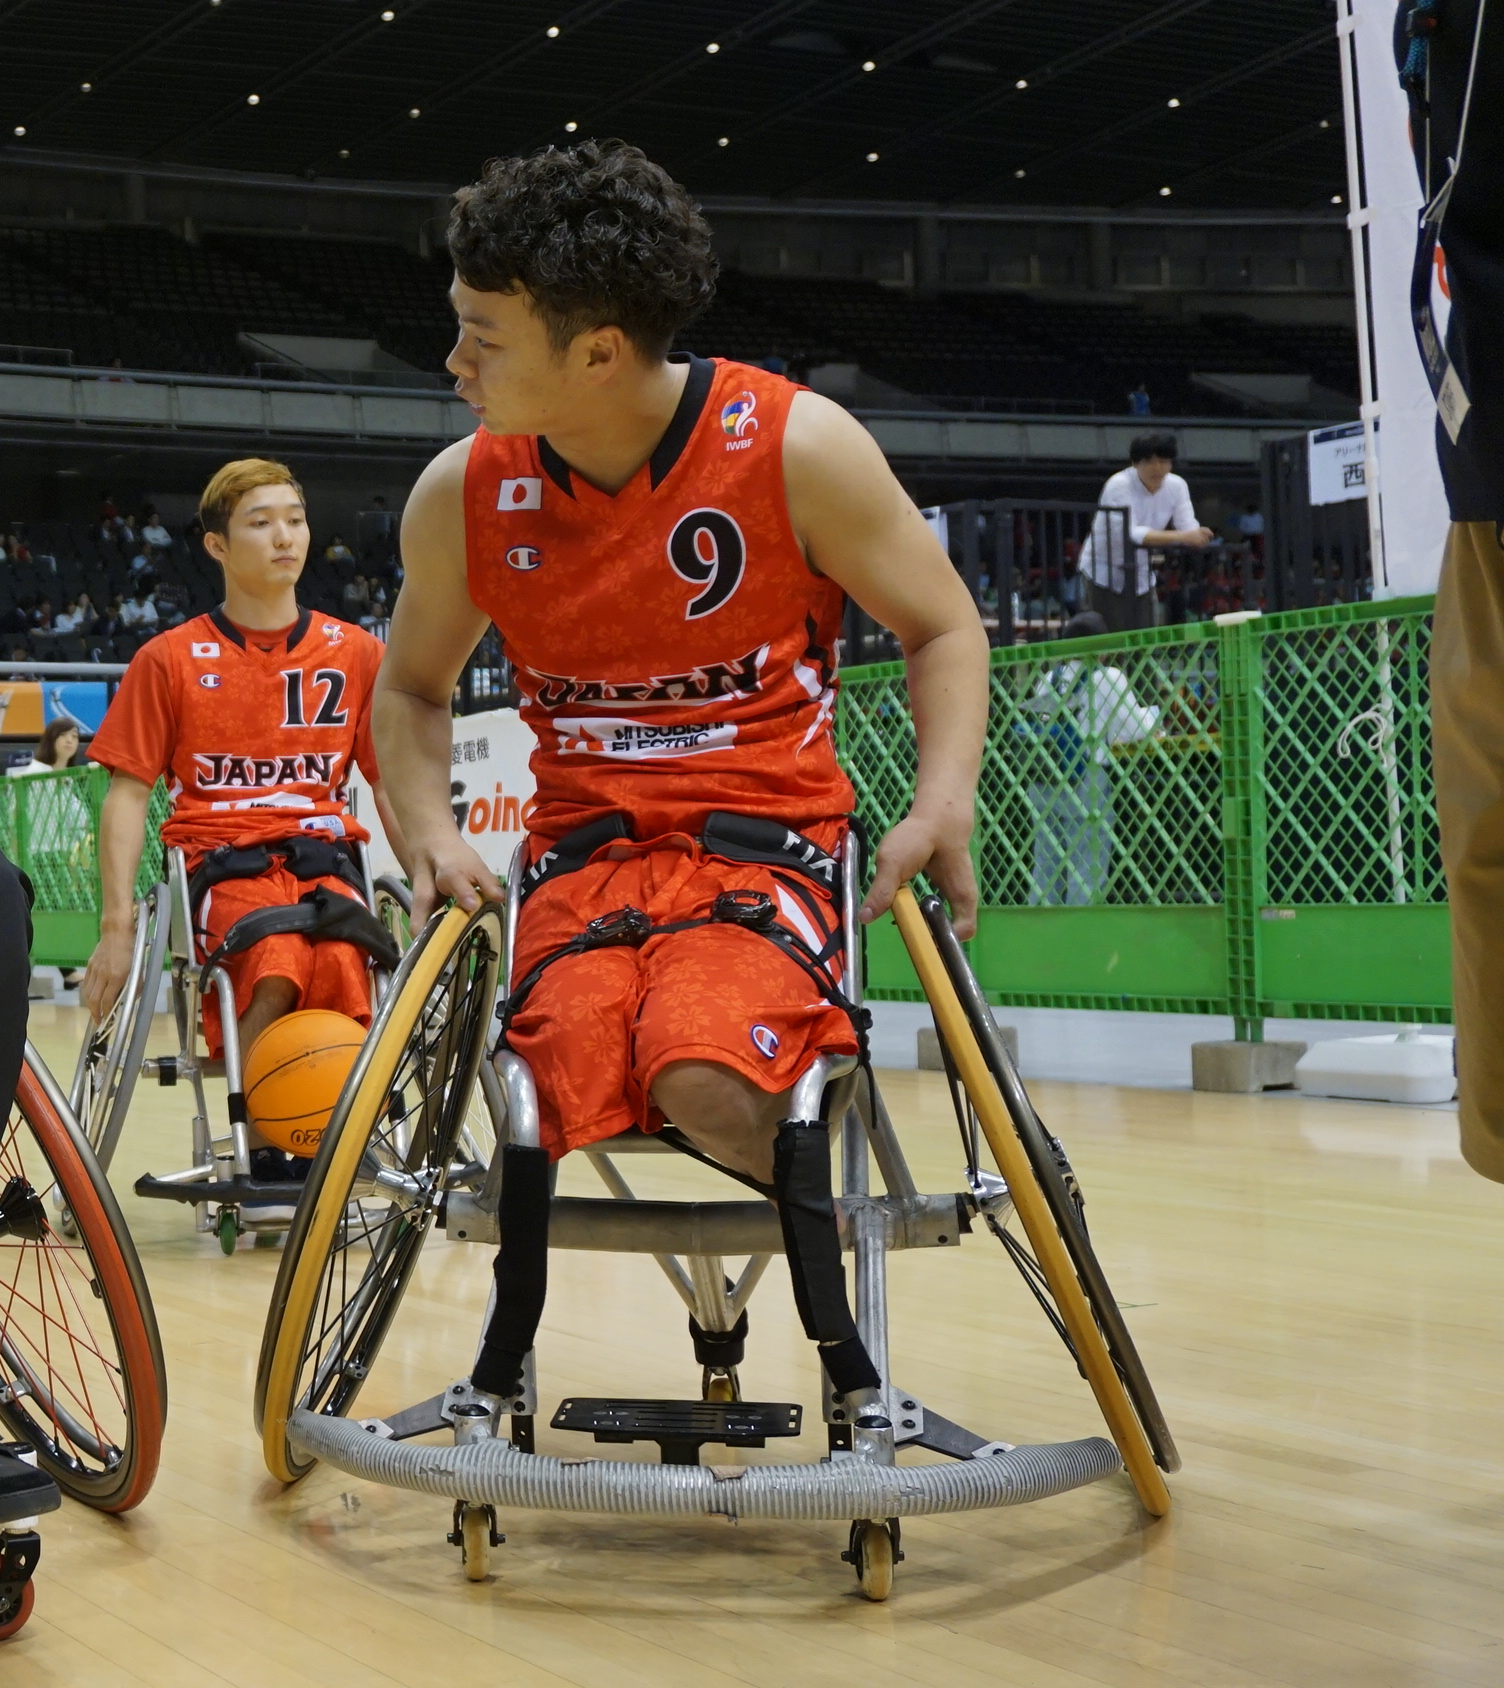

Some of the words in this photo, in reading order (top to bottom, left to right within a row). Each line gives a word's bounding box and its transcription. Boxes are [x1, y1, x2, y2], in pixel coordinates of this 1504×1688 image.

[726, 438, 754, 451] IWBF
[1335, 443, 1366, 456] アリーナ
[667, 507, 746, 620] 9
[280, 668, 349, 728] 12
[192, 752, 343, 790] JAPAN
[291, 1129, 325, 1147] 20
